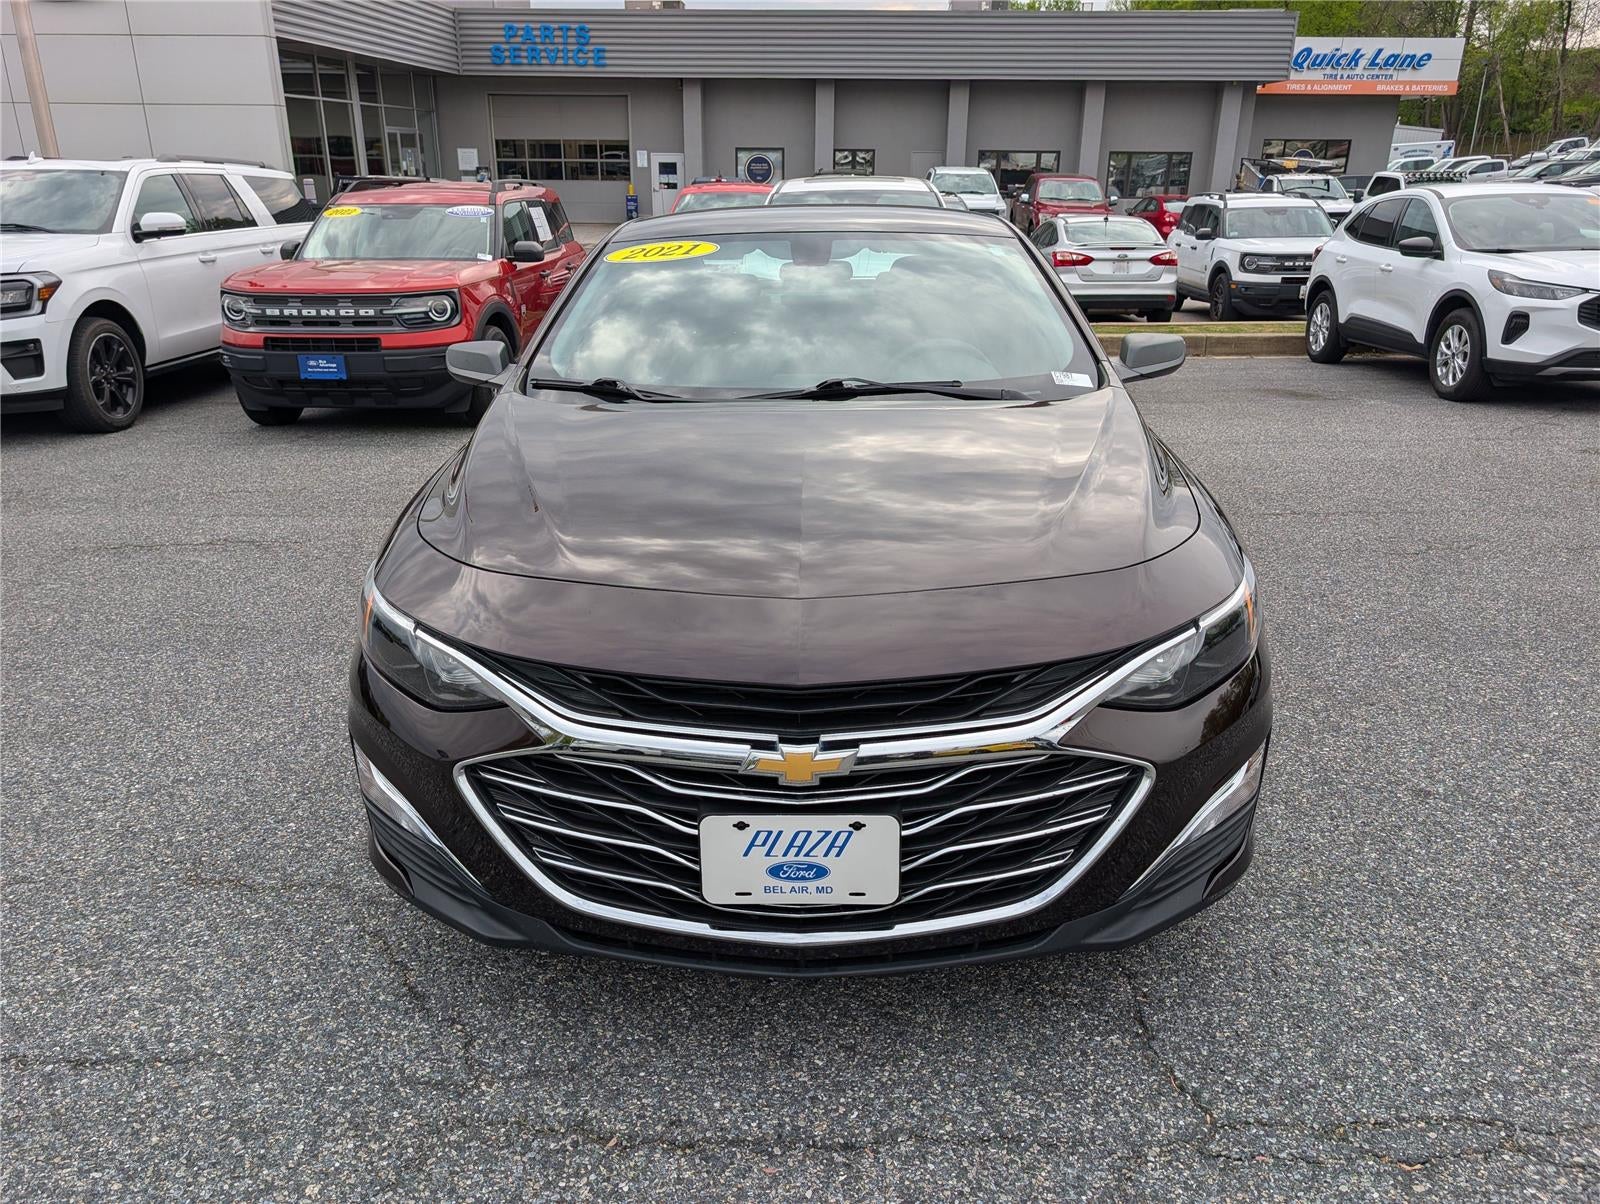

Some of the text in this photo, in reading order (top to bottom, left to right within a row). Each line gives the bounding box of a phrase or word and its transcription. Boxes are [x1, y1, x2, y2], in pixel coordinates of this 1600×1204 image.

[503, 23, 591, 46] PARTS
[490, 44, 608, 67] SERVICE
[1290, 46, 1433, 72] Quick Lane
[1286, 83, 1353, 91] TIRES & ALIGNMENT
[1376, 84, 1448, 92] BRAKES & BATTERIES
[620, 243, 703, 260] 2021
[265, 308, 375, 316] BRONCO
[742, 829, 854, 858] PLAZA
[779, 863, 817, 879] Ford
[763, 885, 834, 895] BEL AIR, MD
